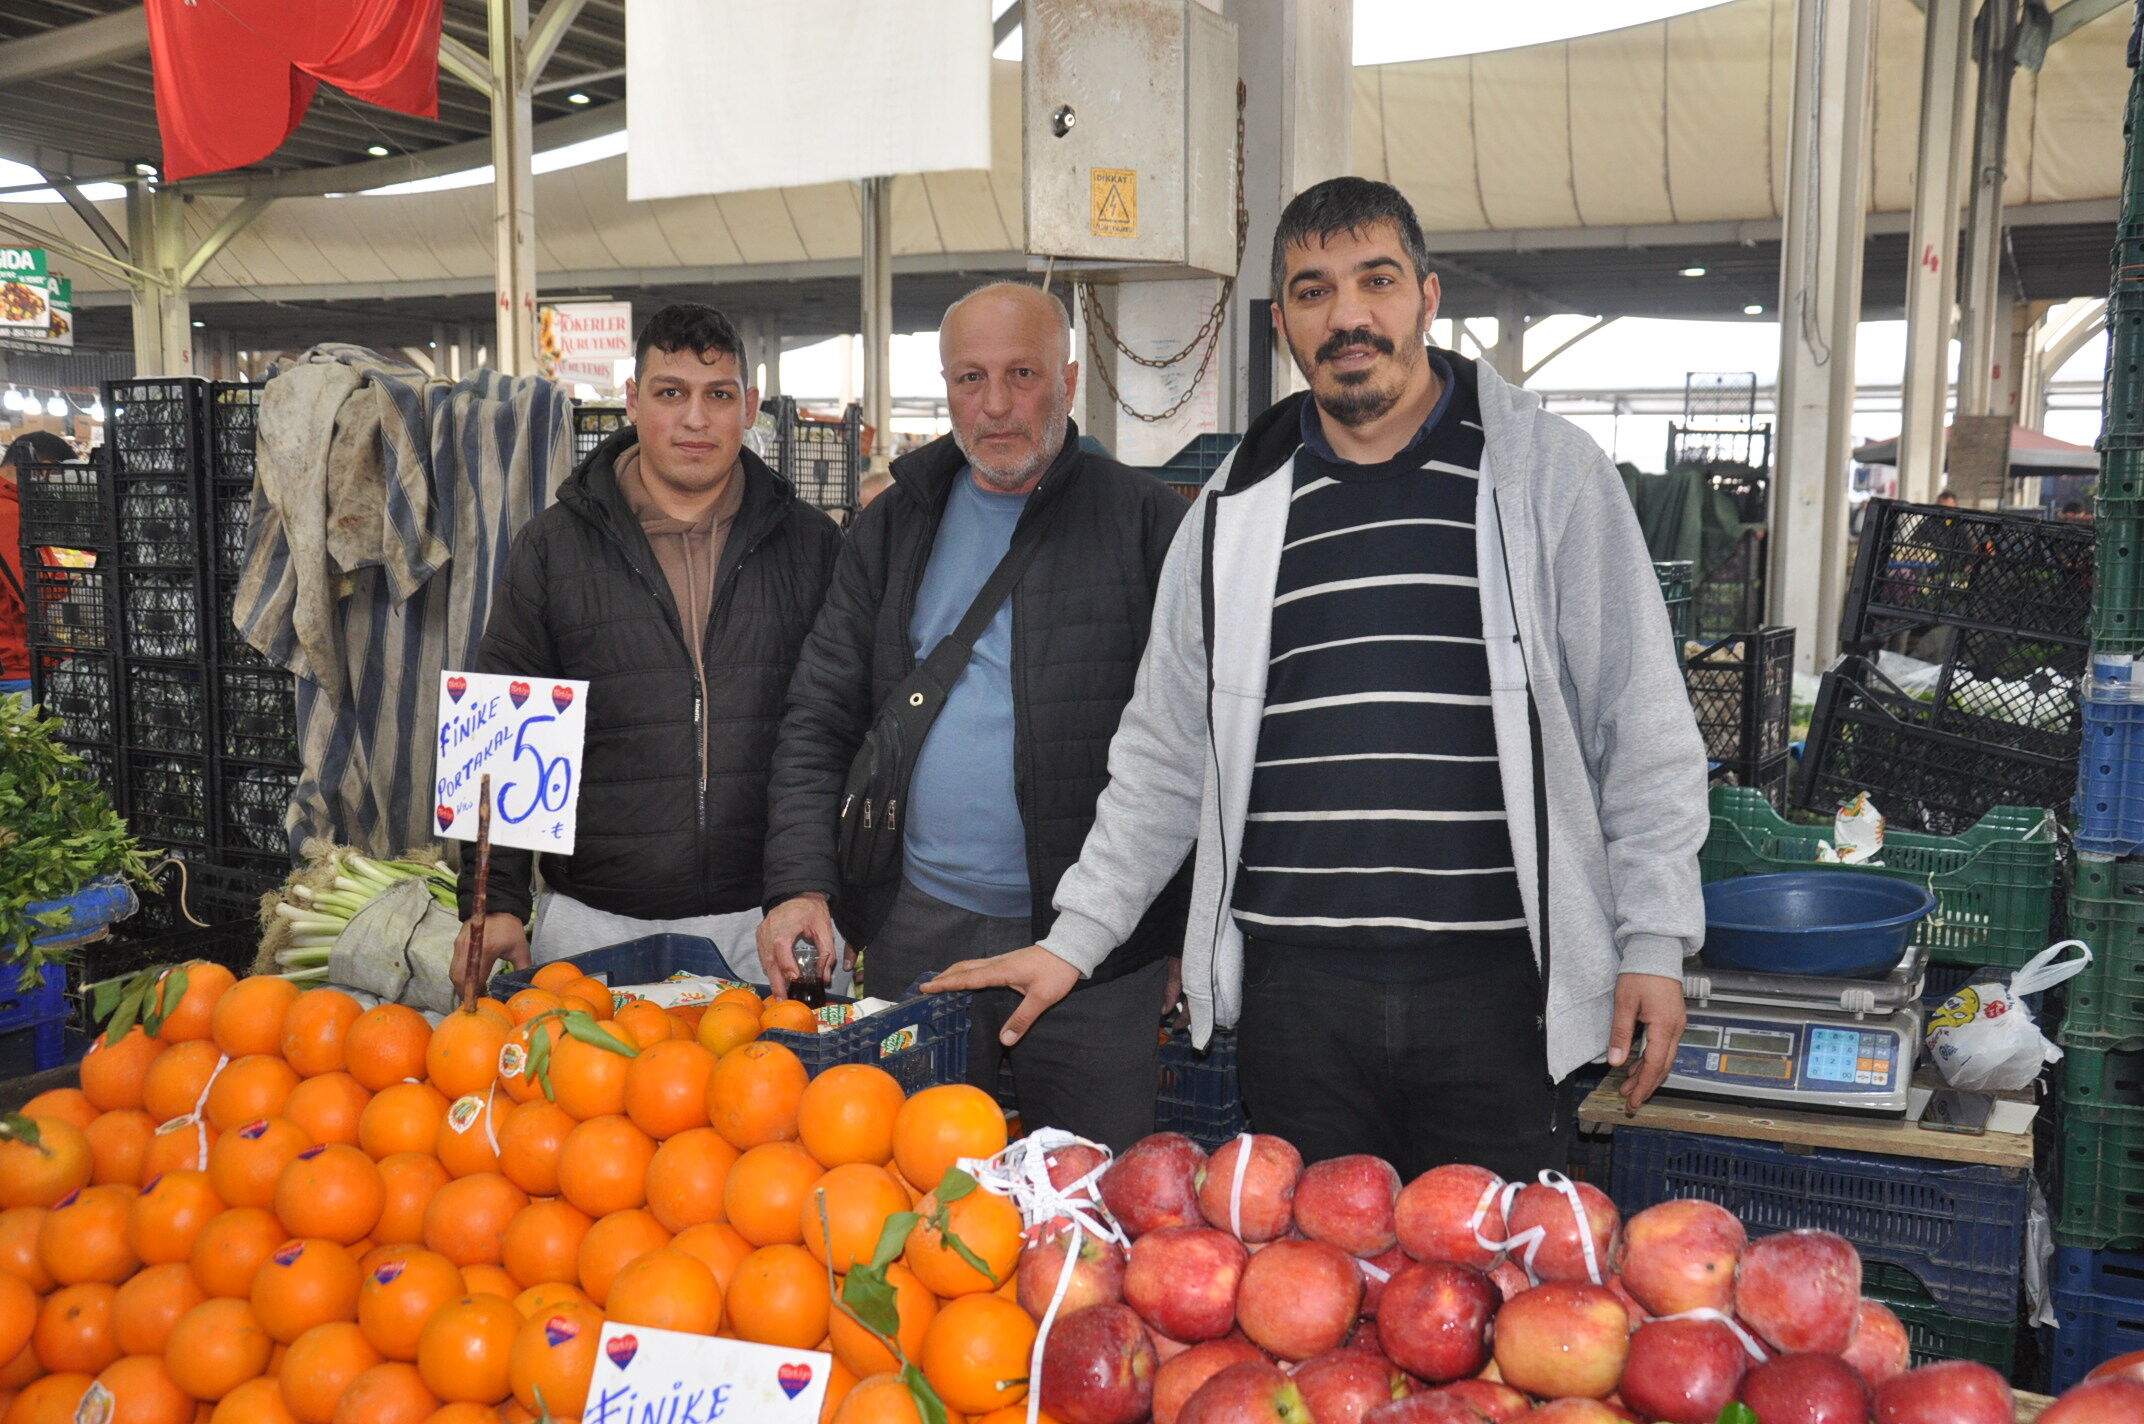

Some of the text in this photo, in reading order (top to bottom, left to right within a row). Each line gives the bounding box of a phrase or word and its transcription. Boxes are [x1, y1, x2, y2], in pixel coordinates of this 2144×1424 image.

[0, 249, 36, 270] IDA
[438, 726, 514, 805] PORTAKAL
[497, 715, 572, 825] 50
